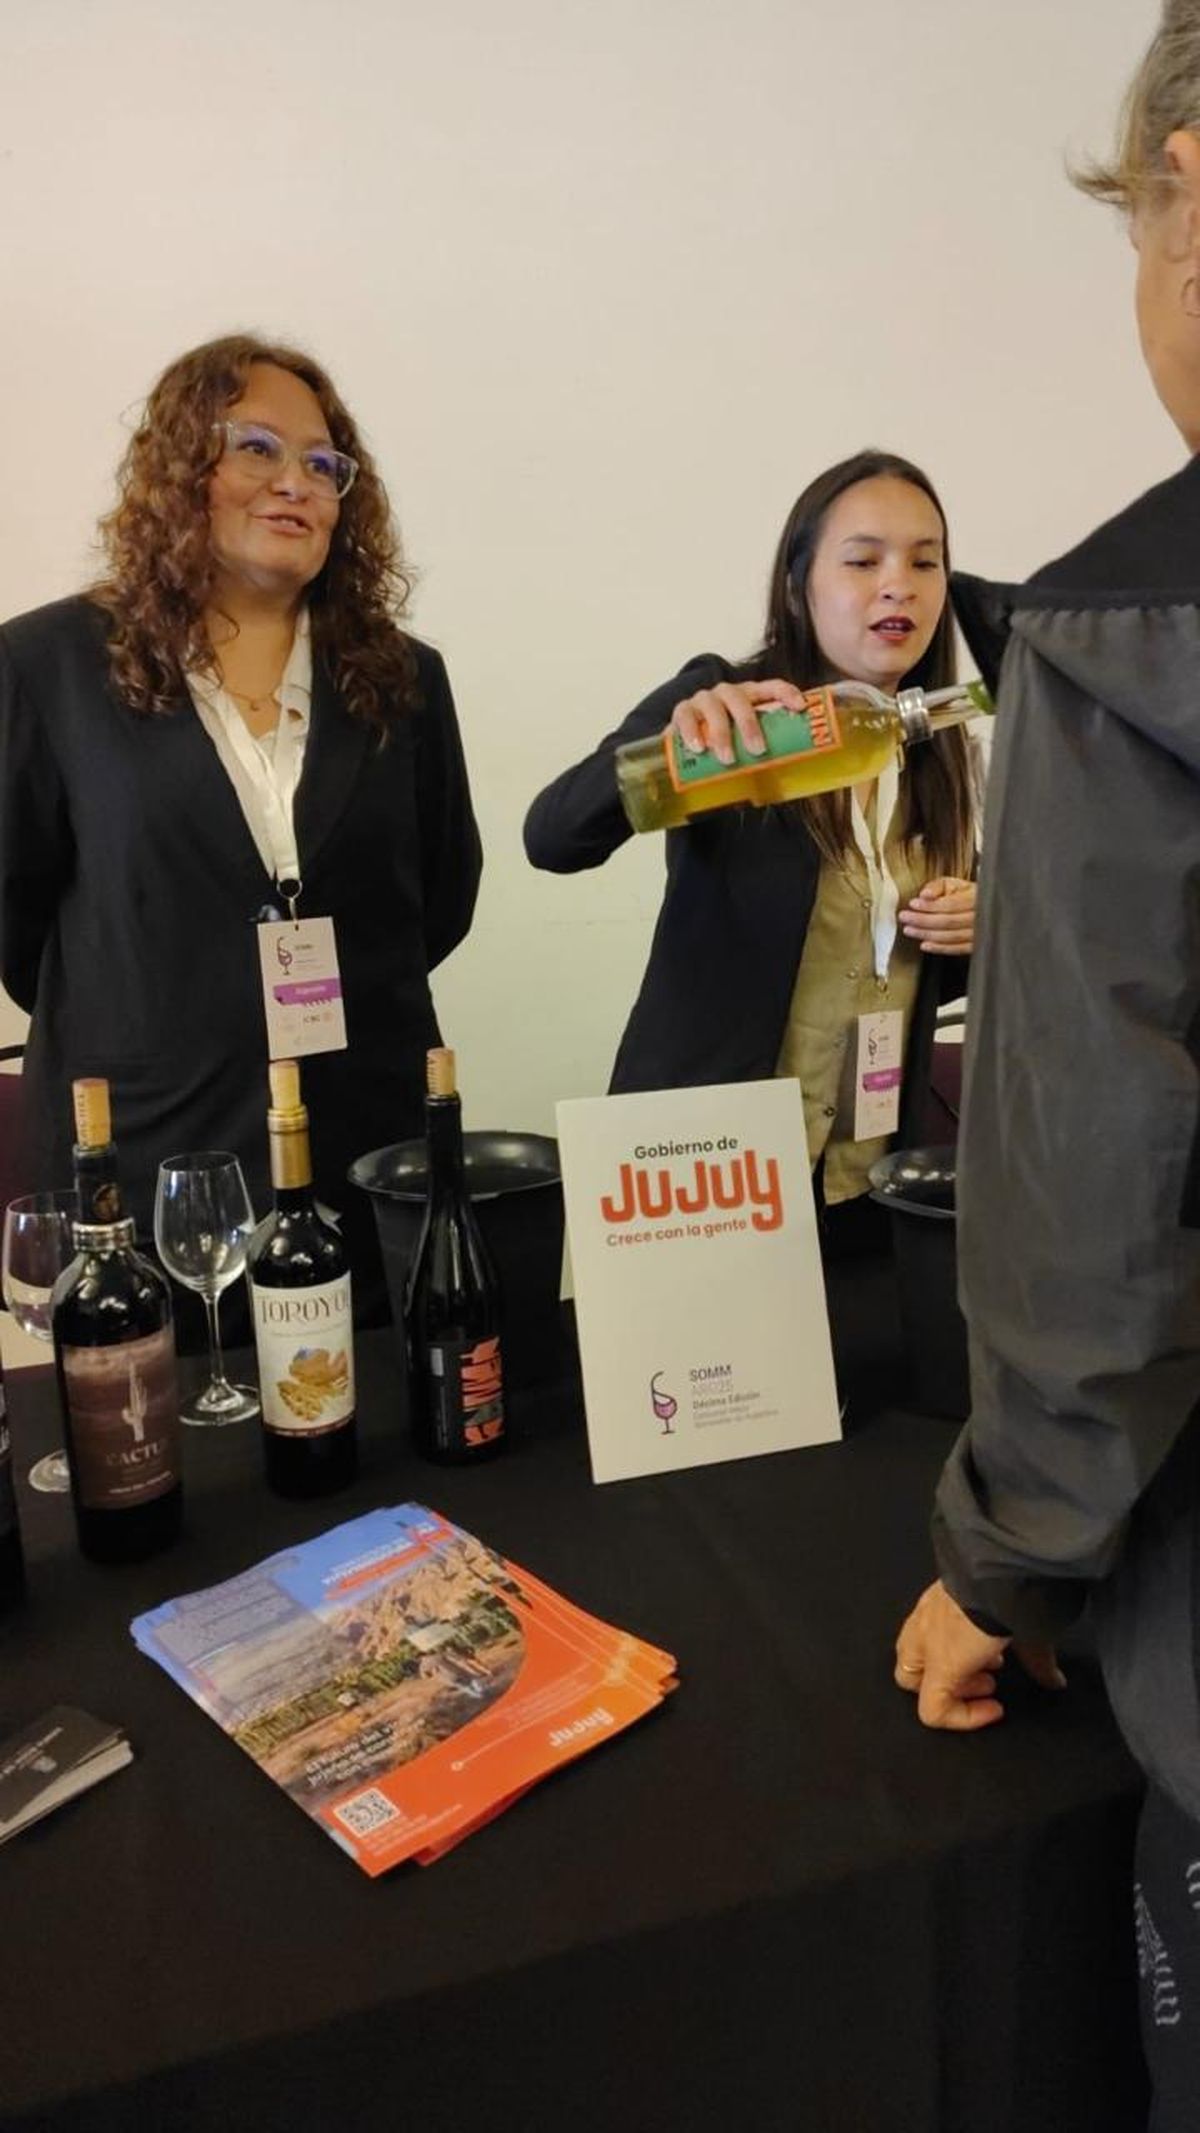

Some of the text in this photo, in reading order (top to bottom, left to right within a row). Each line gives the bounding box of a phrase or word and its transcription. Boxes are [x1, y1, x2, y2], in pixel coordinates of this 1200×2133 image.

[634, 1136, 739, 1160] Gobierno de
[606, 1219, 747, 1247] Crece con la gente
[690, 1365, 732, 1381] SOMM
